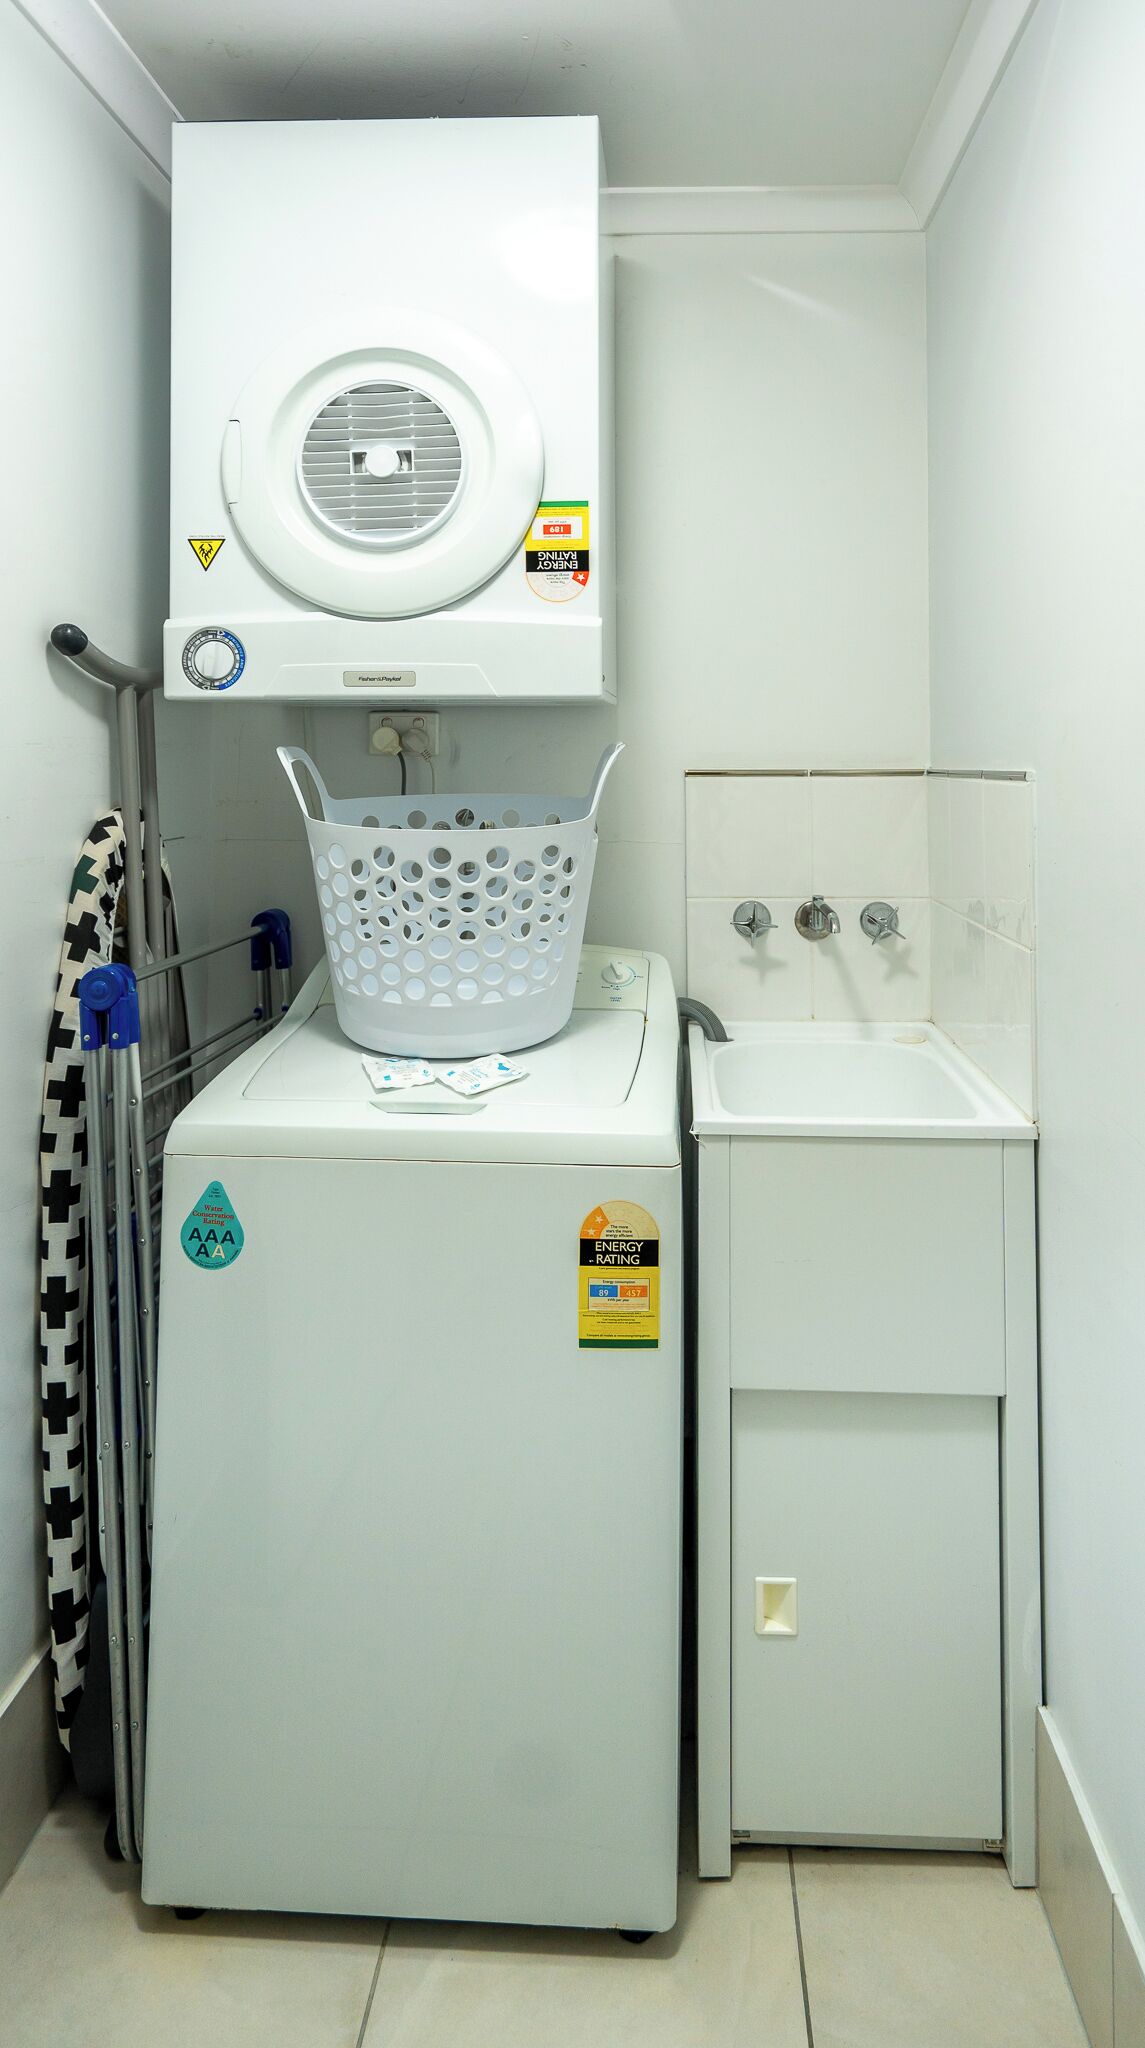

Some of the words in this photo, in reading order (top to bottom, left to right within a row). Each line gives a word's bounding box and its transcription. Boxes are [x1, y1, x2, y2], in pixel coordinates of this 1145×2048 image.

[538, 551, 577, 560] RATING
[536, 560, 578, 570] ENERGY
[192, 1210, 234, 1220] Conservation
[202, 1218, 224, 1226] Rating
[595, 1241, 644, 1252] ENERGY
[596, 1254, 640, 1265] RATING
[626, 1289, 641, 1297] 457
